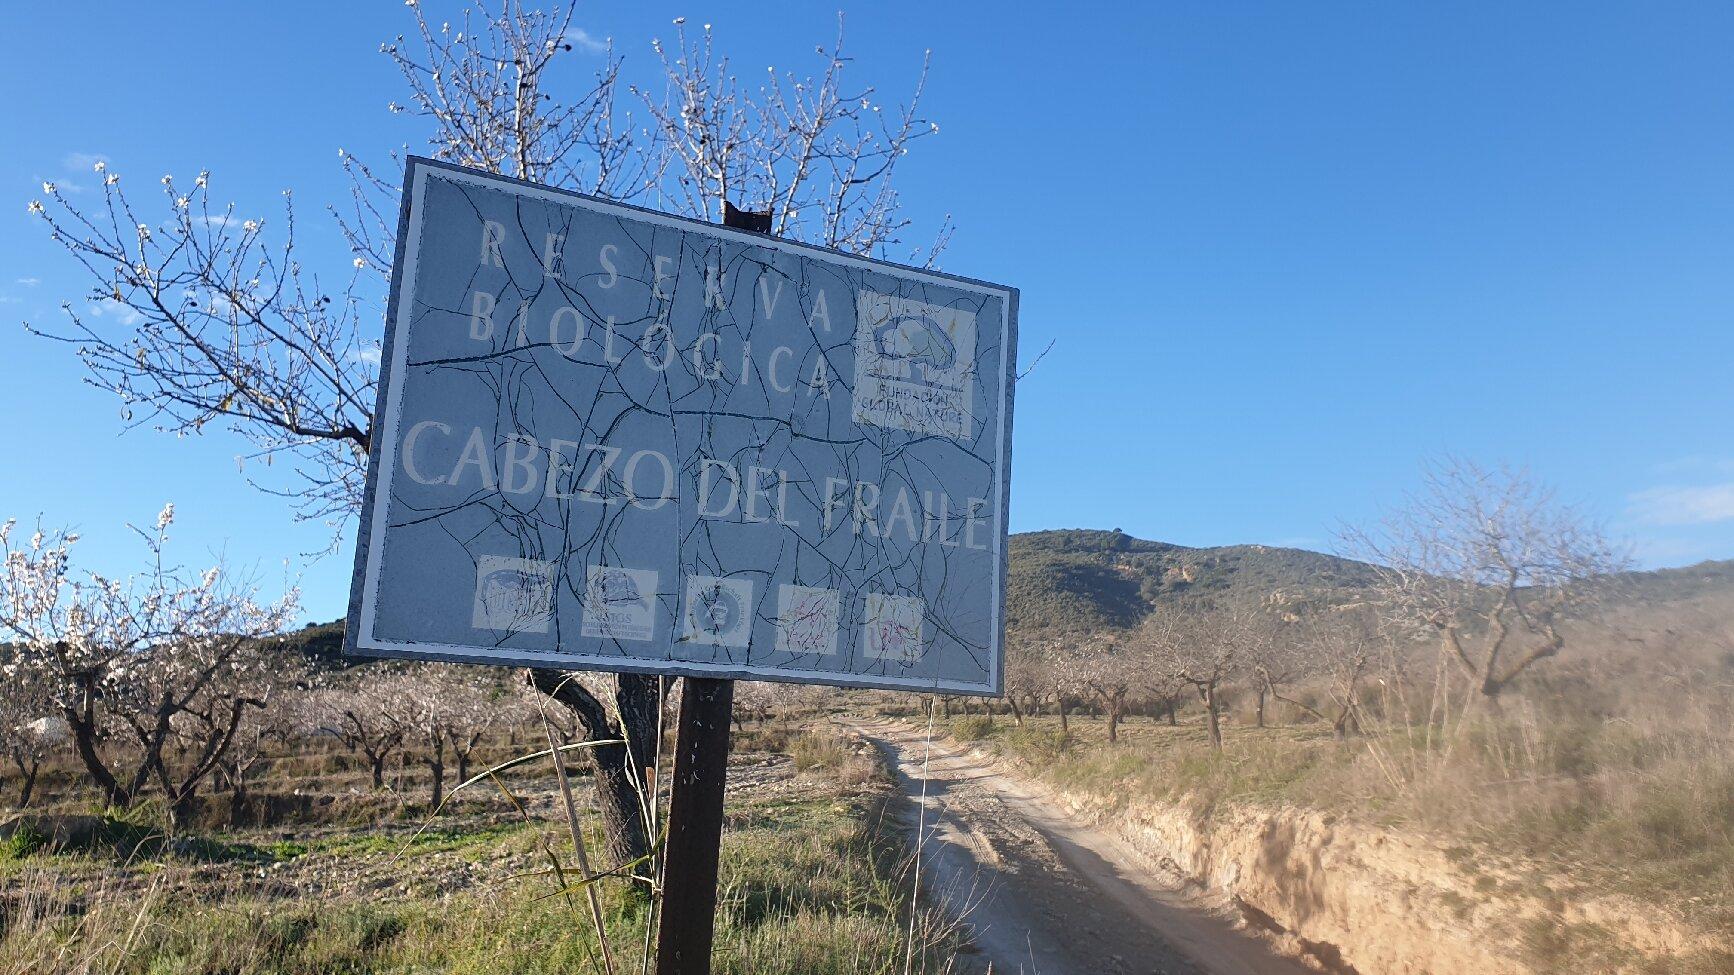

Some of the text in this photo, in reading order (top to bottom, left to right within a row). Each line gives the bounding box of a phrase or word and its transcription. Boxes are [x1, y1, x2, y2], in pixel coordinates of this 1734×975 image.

[480, 220, 832, 333] RESERVA
[402, 420, 989, 549] CABEZO DEL FRAILE
